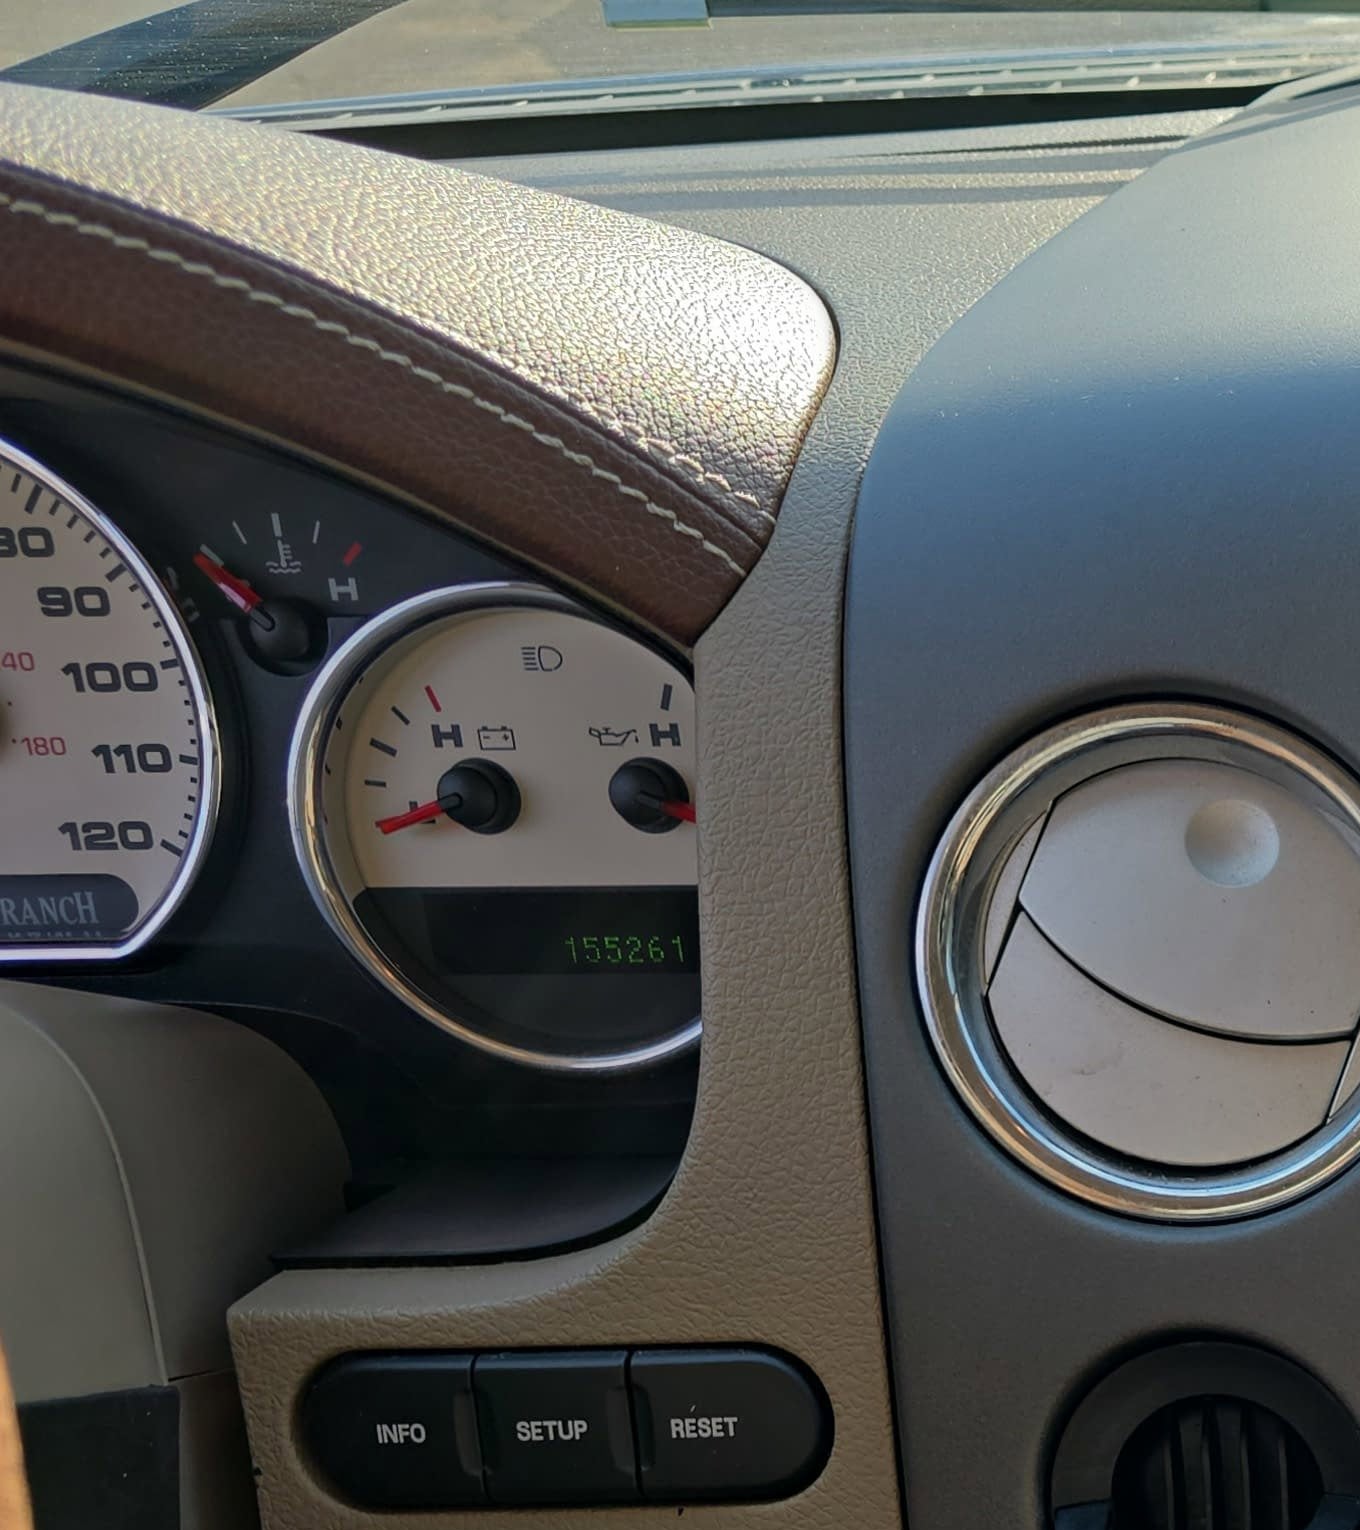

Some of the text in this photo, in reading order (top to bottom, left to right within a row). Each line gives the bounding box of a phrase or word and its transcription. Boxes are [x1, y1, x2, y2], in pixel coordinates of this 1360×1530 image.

[37, 586, 111, 617] 90
[61, 661, 159, 693] 100
[21, 736, 67, 756] 180
[431, 723, 464, 748] H
[648, 722, 682, 747] H
[91, 743, 173, 774] 110
[57, 820, 154, 851] 120
[1, 890, 99, 927] RANCH
[564, 935, 684, 963] 155261
[375, 1423, 426, 1445] INFO
[515, 1419, 589, 1442] SETUP
[670, 1416, 739, 1439] RESET
